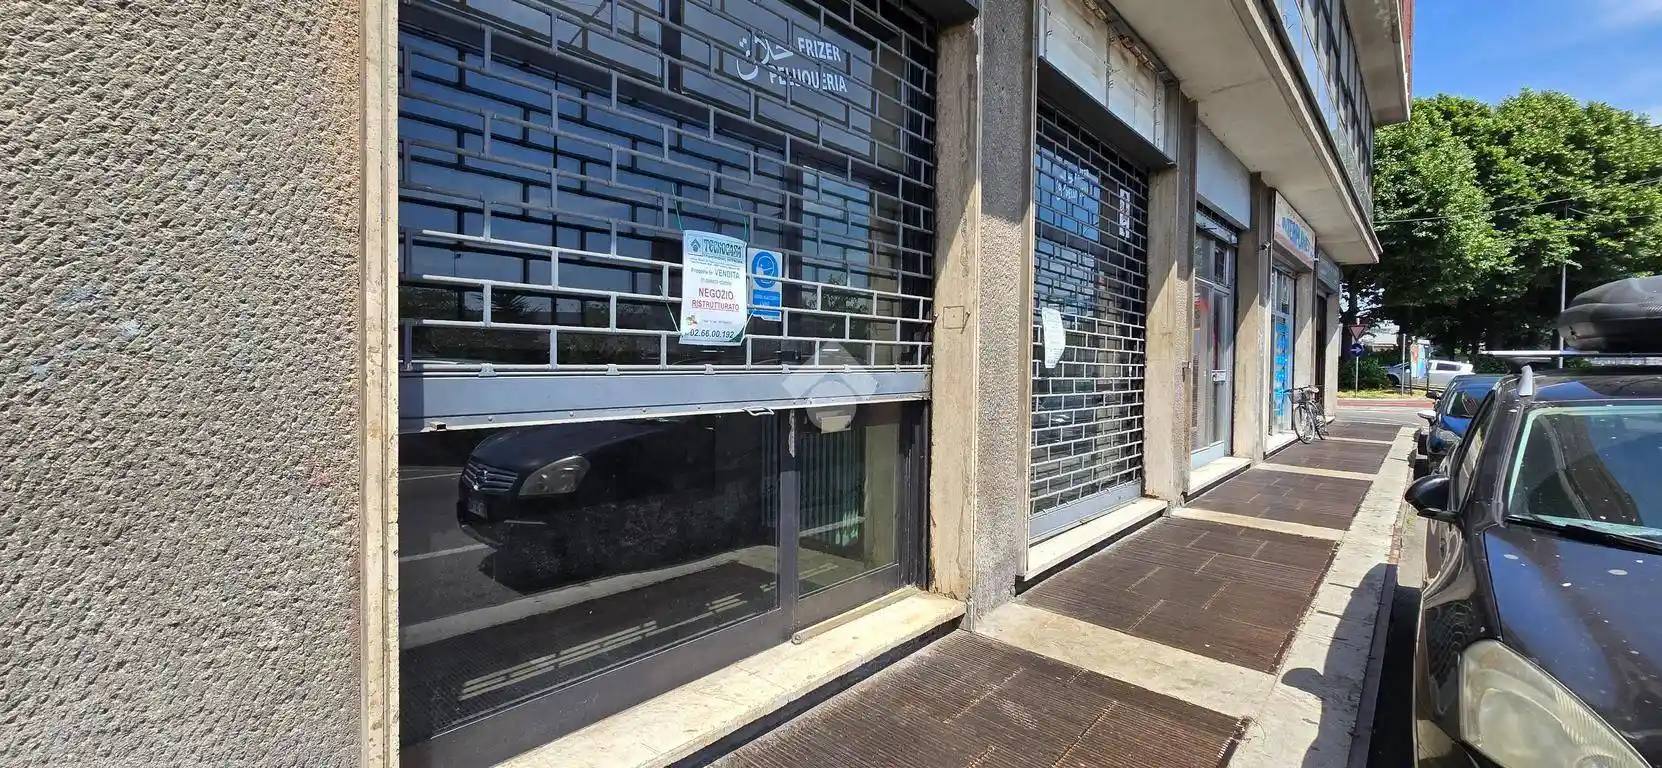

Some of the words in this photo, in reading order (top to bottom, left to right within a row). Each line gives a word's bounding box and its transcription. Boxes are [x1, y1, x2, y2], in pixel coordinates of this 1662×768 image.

[797, 37, 842, 62] FRIZER
[704, 239, 742, 258] TECNOCASA
[715, 269, 740, 279] VENDITA
[698, 287, 734, 300] NEGOZIO
[692, 300, 740, 311] RISTRUTTURATO
[690, 328, 734, 338] 02.66.00.192
